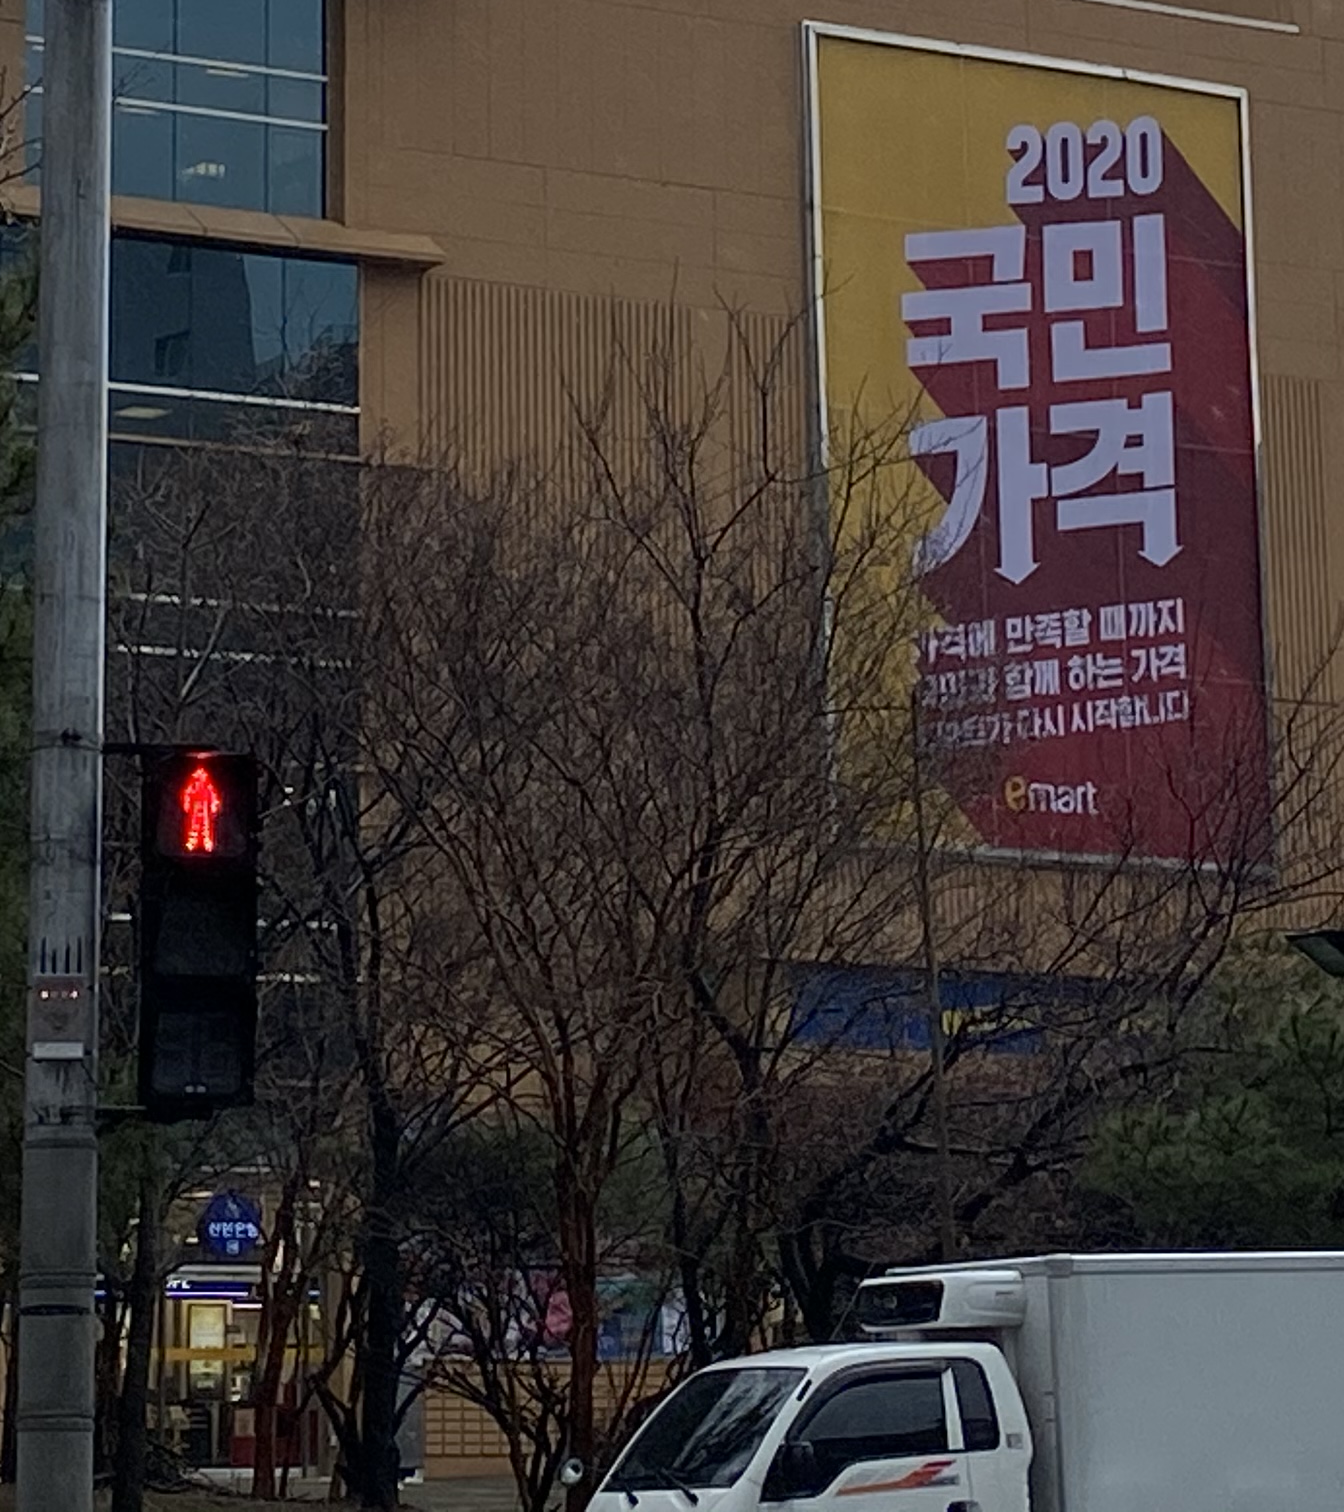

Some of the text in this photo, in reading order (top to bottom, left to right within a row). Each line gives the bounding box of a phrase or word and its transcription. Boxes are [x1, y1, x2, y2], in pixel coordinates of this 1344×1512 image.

[1005, 115, 1164, 205] 2020
[901, 213, 1172, 390] 국민
[909, 391, 1184, 584] 가격
[1005, 607, 1091, 654] 만족할
[1099, 597, 1185, 641] 때까지
[1004, 658, 1060, 701] 함께
[1067, 653, 1123, 691] 하는
[1129, 642, 1187, 683] 가격
[1005, 775, 1099, 814] emart
